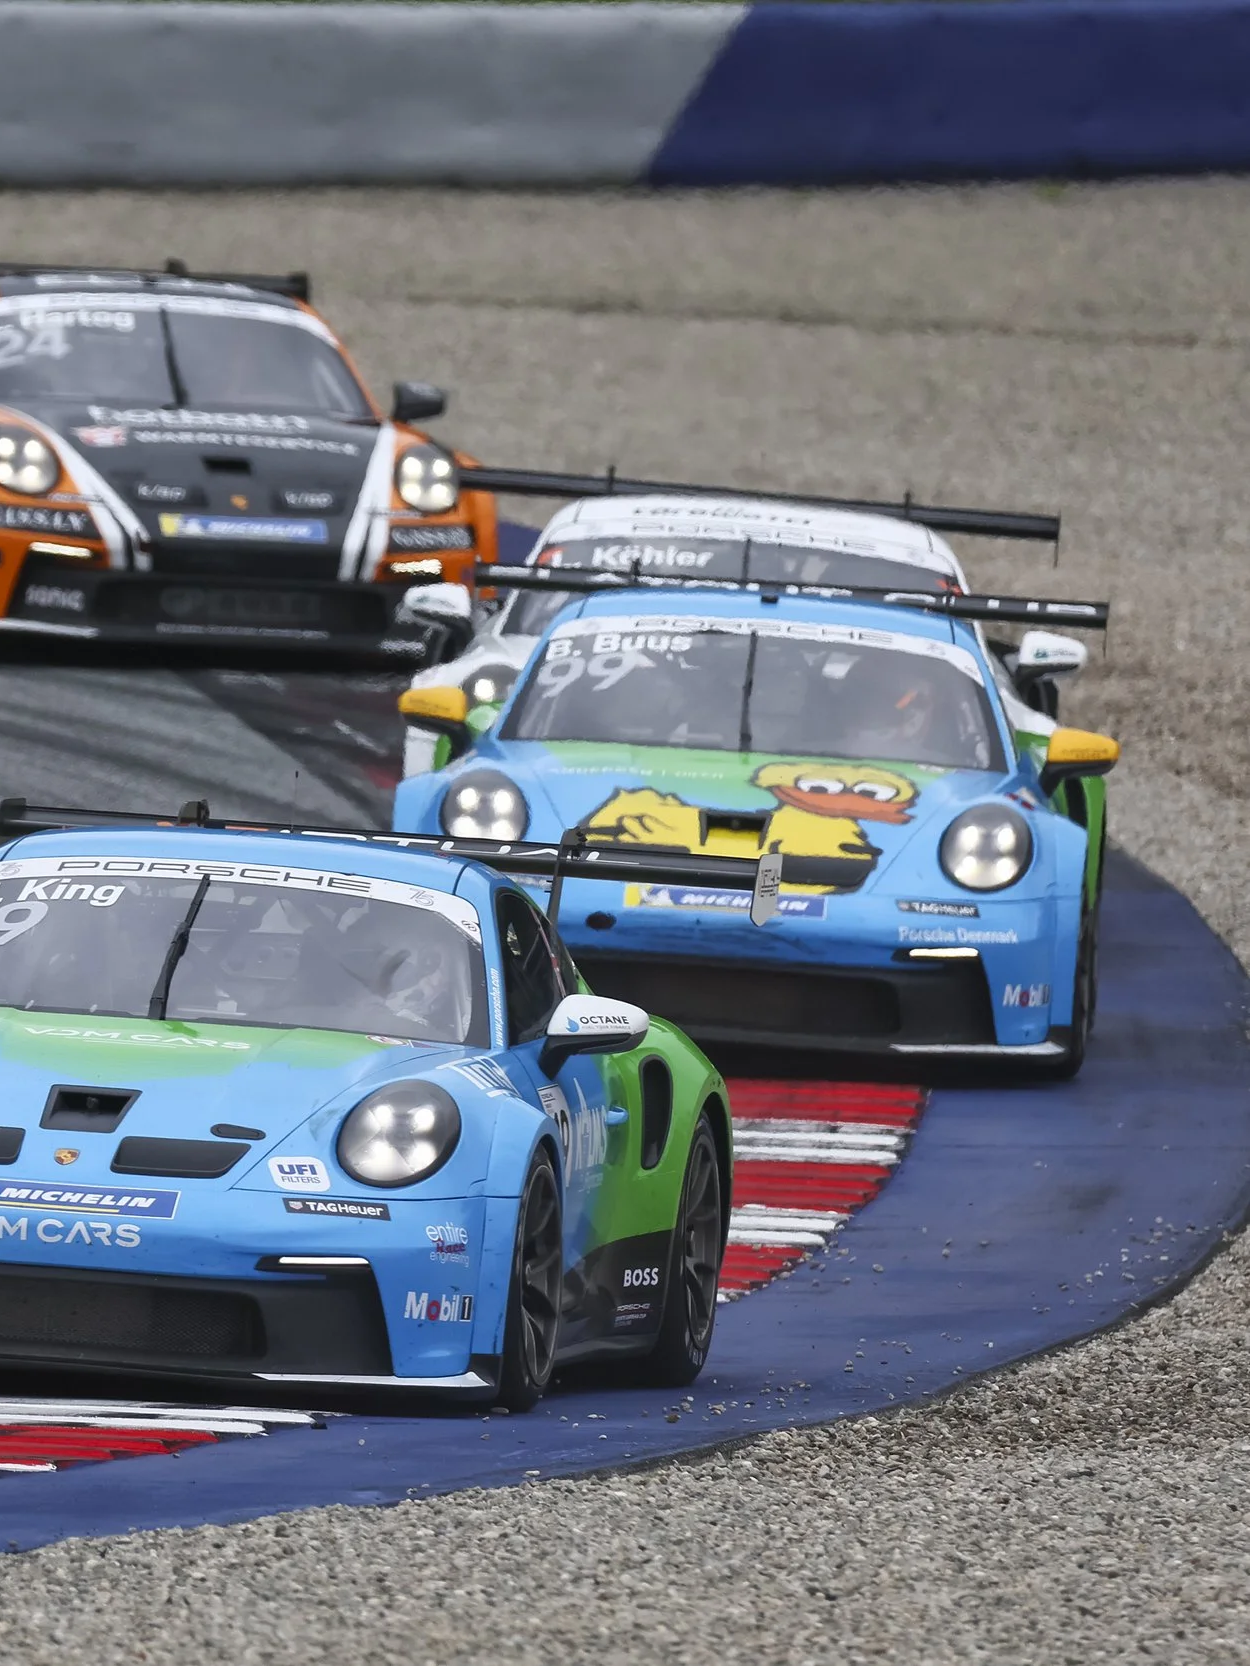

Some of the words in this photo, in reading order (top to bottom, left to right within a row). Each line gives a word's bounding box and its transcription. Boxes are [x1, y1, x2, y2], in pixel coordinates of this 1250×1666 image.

[592, 632, 693, 654] Buus
[57, 860, 372, 893] PORSCHE
[16, 878, 126, 908] King
[680, 892, 810, 912] MICHIN
[579, 1015, 630, 1025] OCTANE
[130, 1033, 252, 1051] CARS
[276, 1164, 318, 1176] UFI
[281, 1175, 322, 1185] FILTERS
[0, 1187, 157, 1208] MICHELIN
[36, 1218, 142, 1248] CARS
[425, 1221, 469, 1245] entire
[623, 1267, 659, 1287] BOSS
[404, 1291, 461, 1322] Mobil
